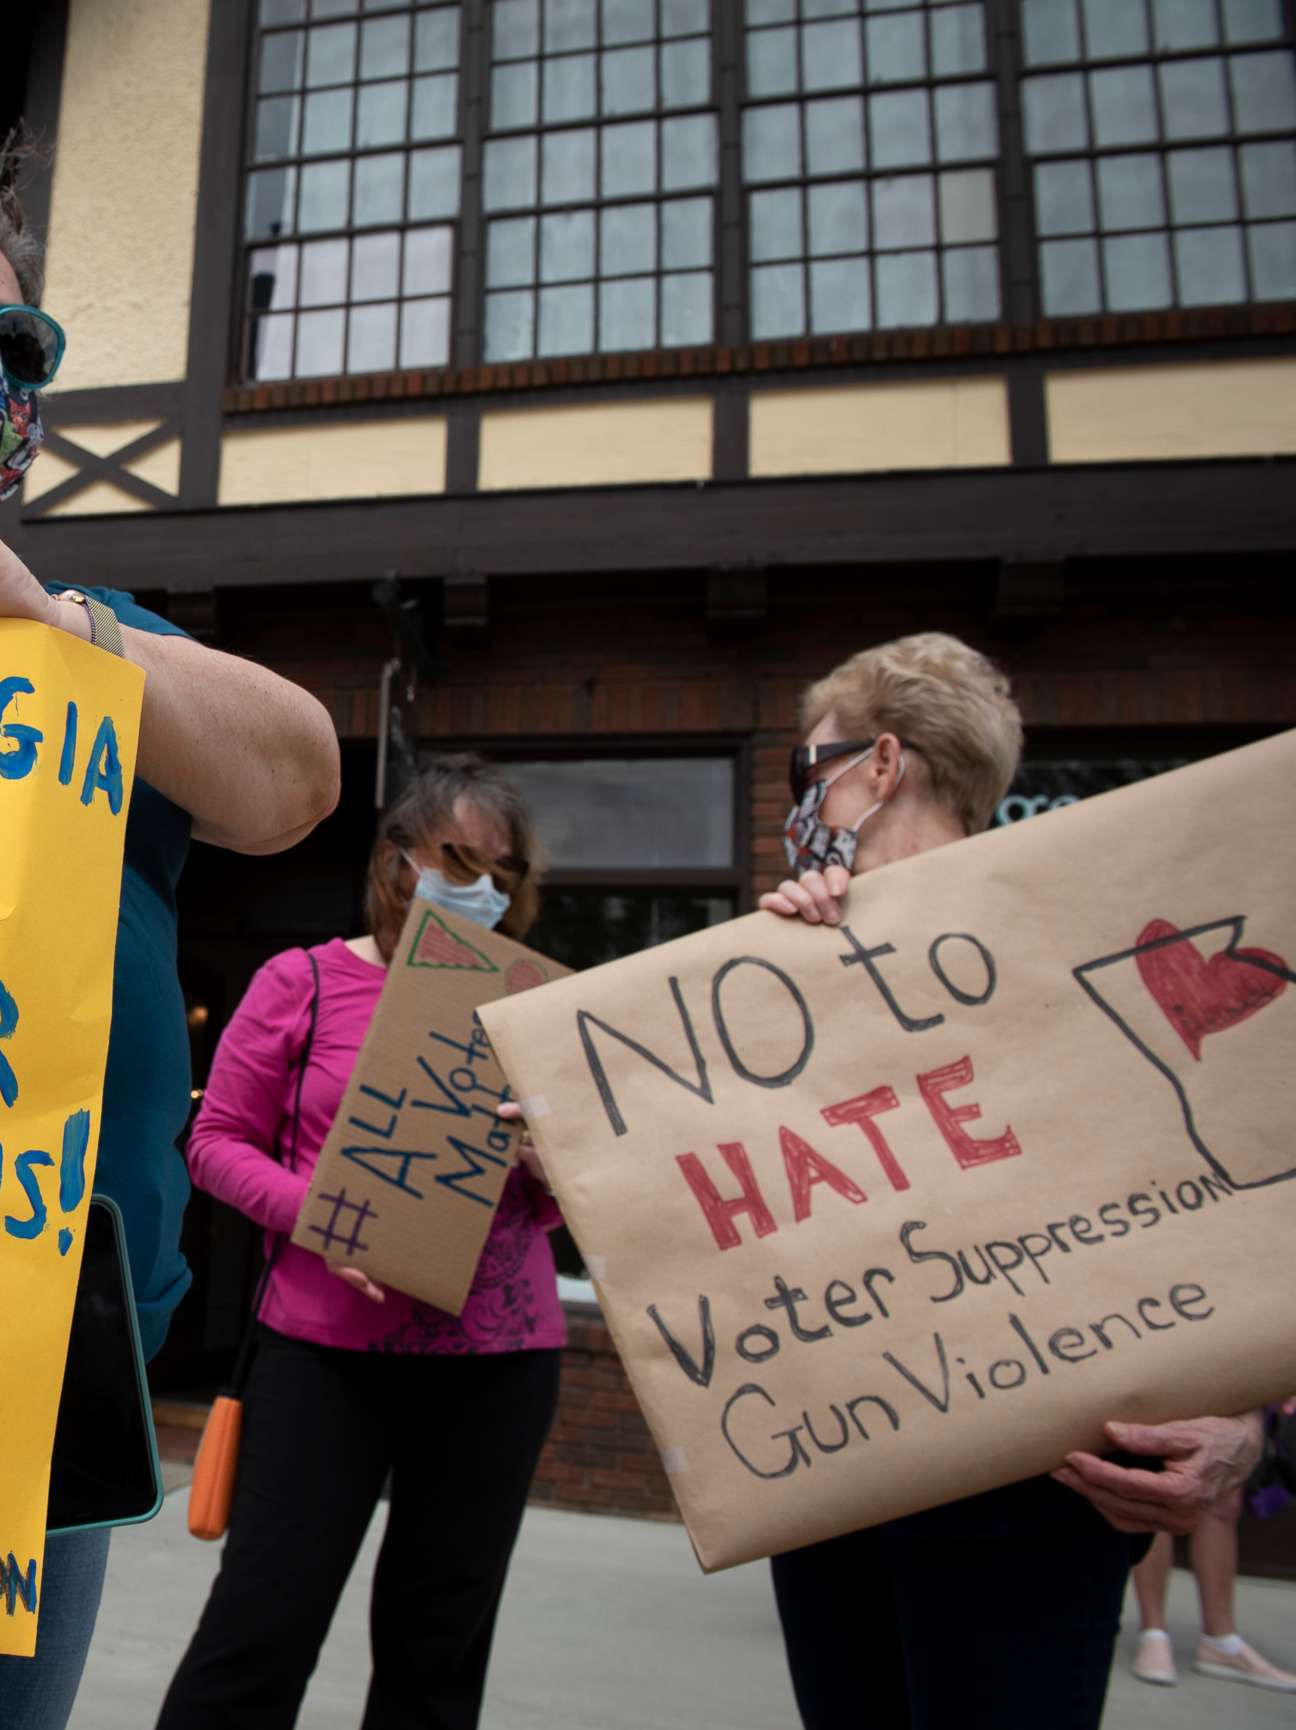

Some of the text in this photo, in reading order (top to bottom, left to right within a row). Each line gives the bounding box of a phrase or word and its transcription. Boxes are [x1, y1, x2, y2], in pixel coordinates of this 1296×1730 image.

[576, 925, 998, 1137] NO to
[674, 1054, 1024, 1252] HATE
[646, 1275, 895, 1388] Voter
[720, 1282, 1216, 1480] Gun Violence
